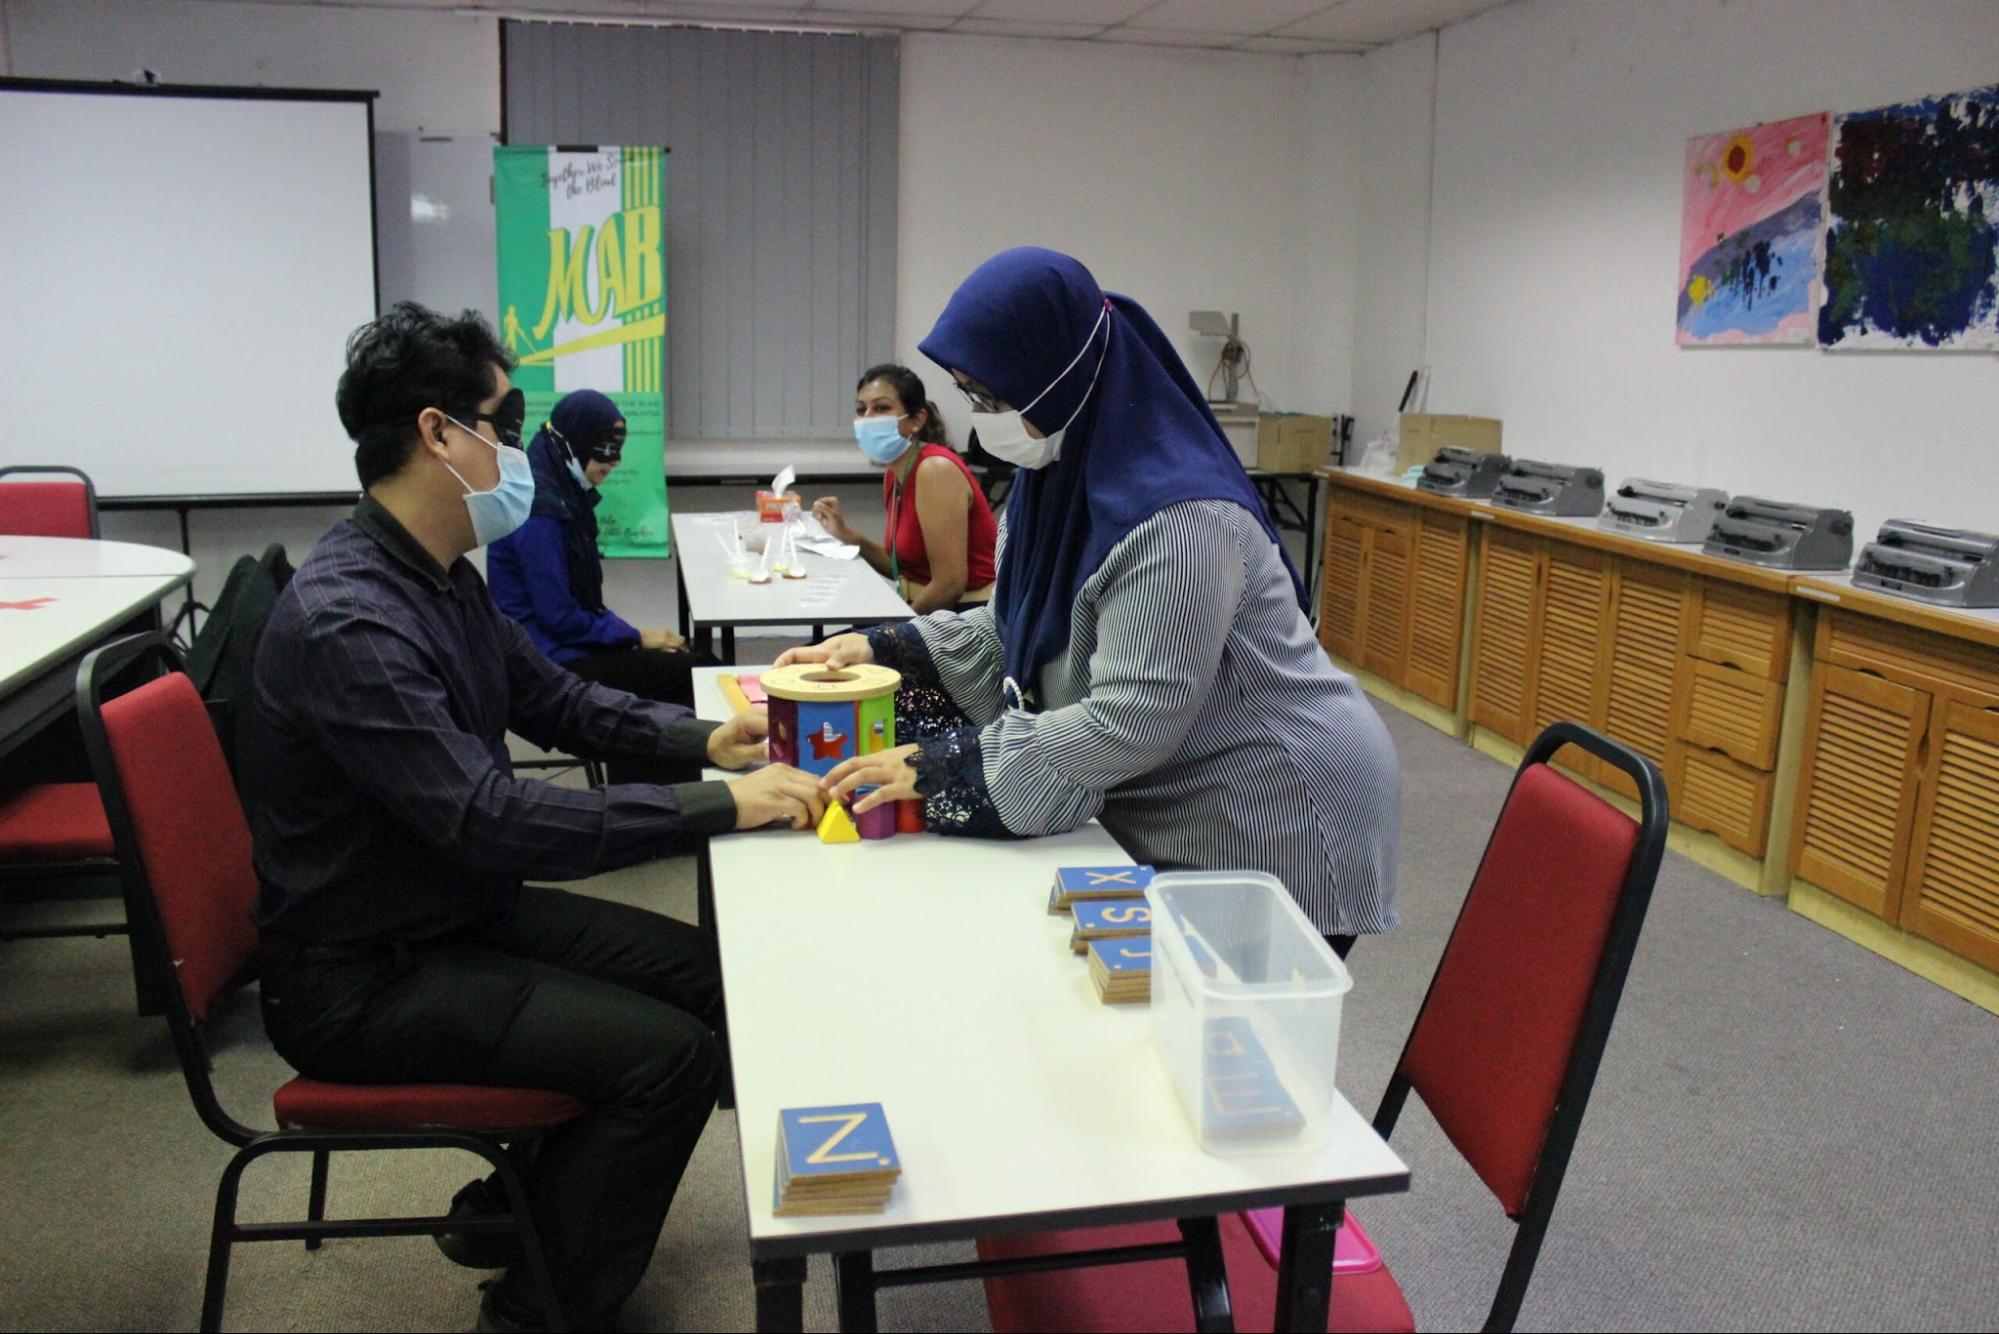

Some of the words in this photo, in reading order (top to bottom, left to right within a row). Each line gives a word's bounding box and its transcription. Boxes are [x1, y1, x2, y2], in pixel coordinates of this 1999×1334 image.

[532, 205, 661, 341] MAB
[1086, 871, 1137, 884] X
[1101, 907, 1153, 923] S
[798, 1112, 878, 1164] Z
